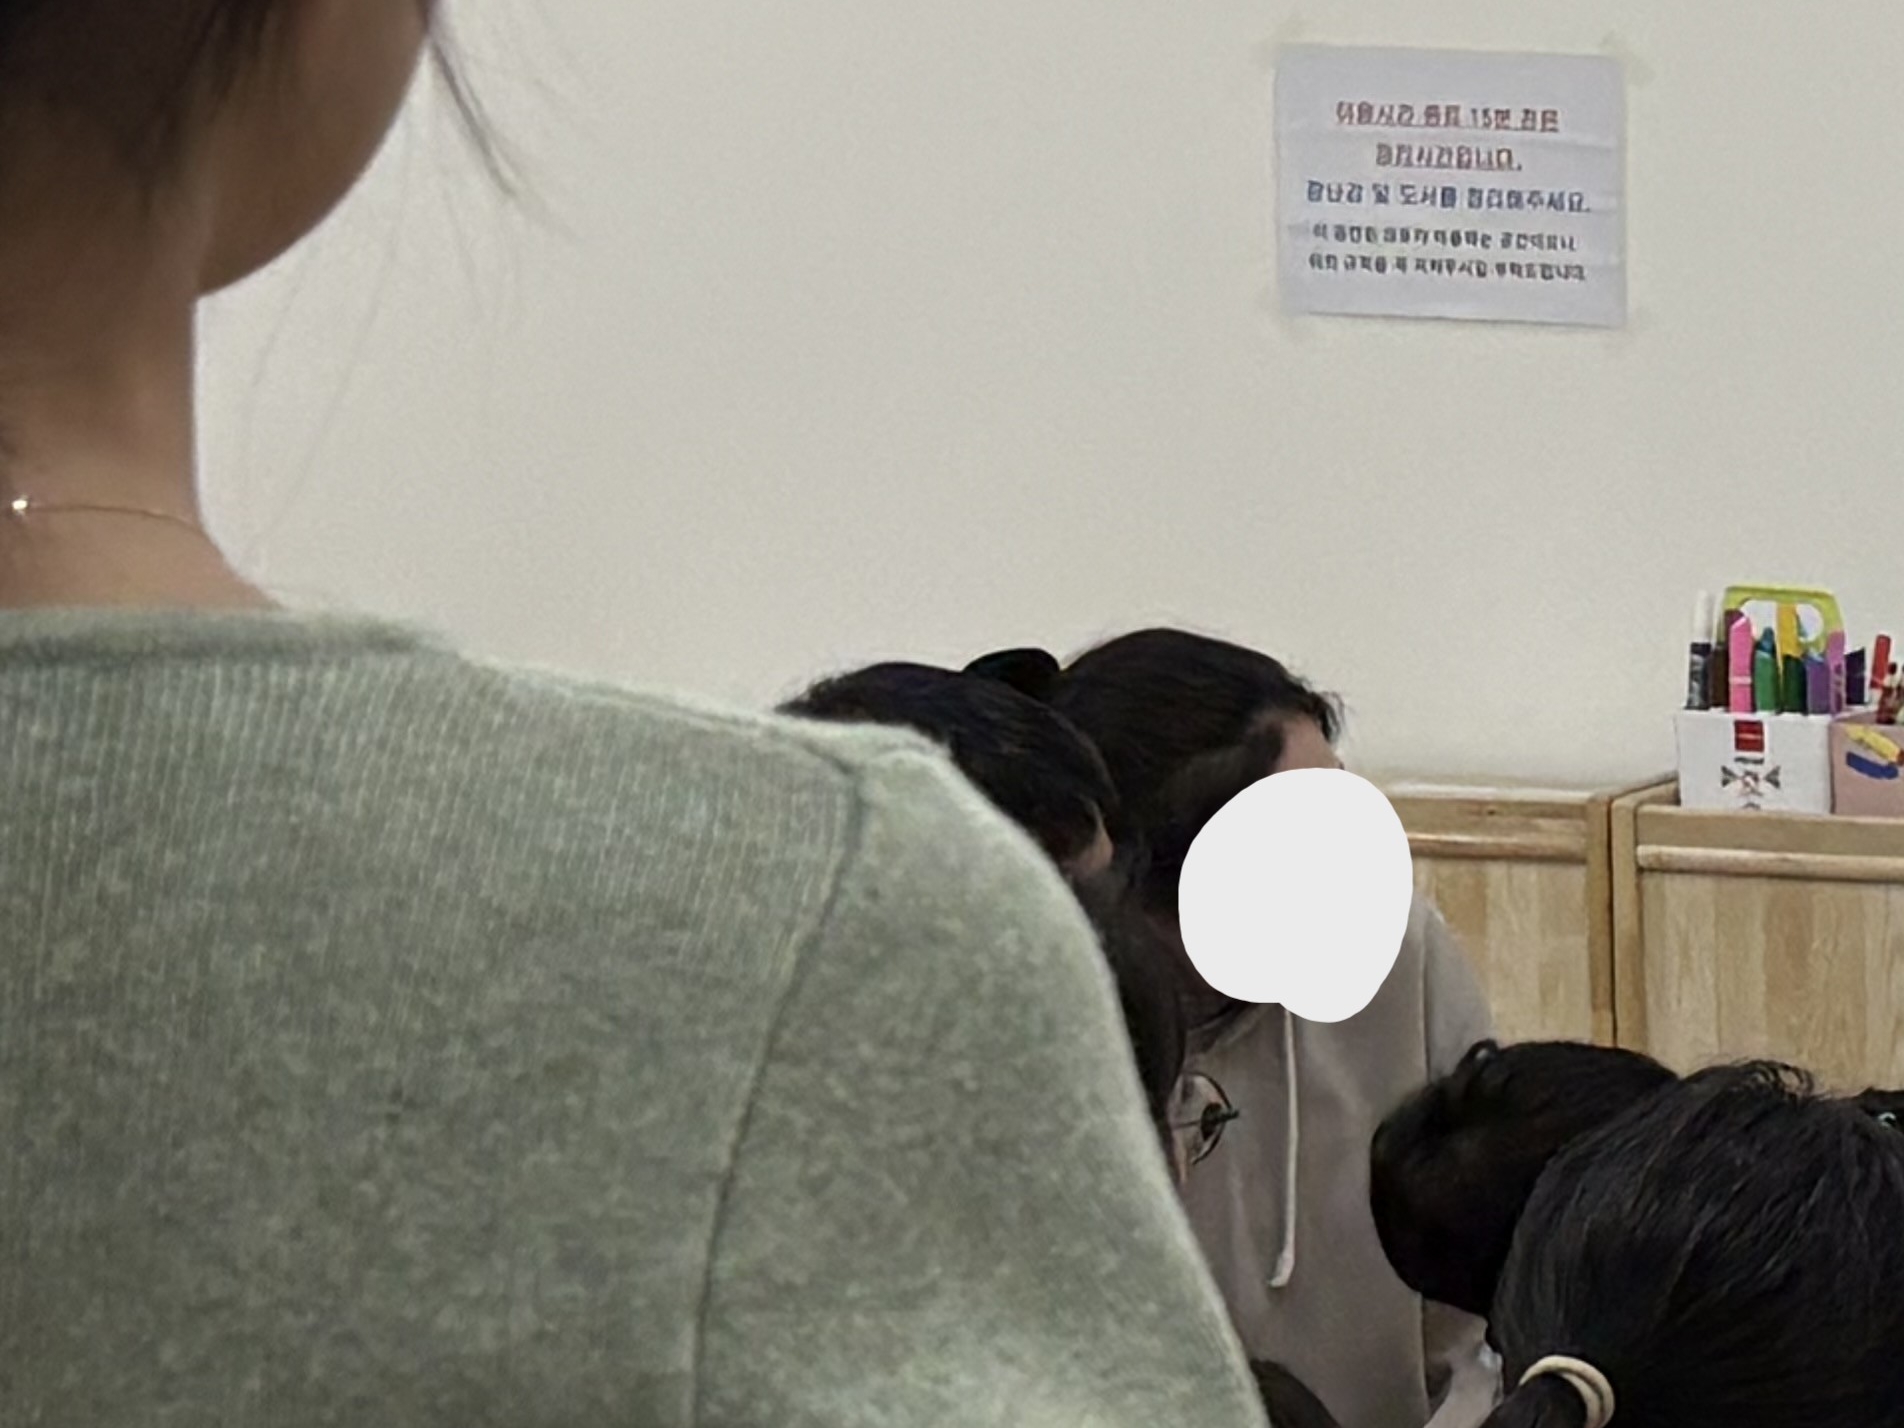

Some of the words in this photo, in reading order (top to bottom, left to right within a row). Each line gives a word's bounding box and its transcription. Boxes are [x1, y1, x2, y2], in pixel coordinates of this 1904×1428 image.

[1336, 100, 1415, 127] 이용시간
[1424, 104, 1461, 128] 종료
[1470, 107, 1511, 130] 15분
[1376, 142, 1523, 172] 정리시간입니다.
[1307, 180, 1363, 203] 장난감
[1372, 183, 1390, 205] 및
[1400, 183, 1457, 209] 도서를
[1467, 187, 1592, 214] 정리해주세요.
